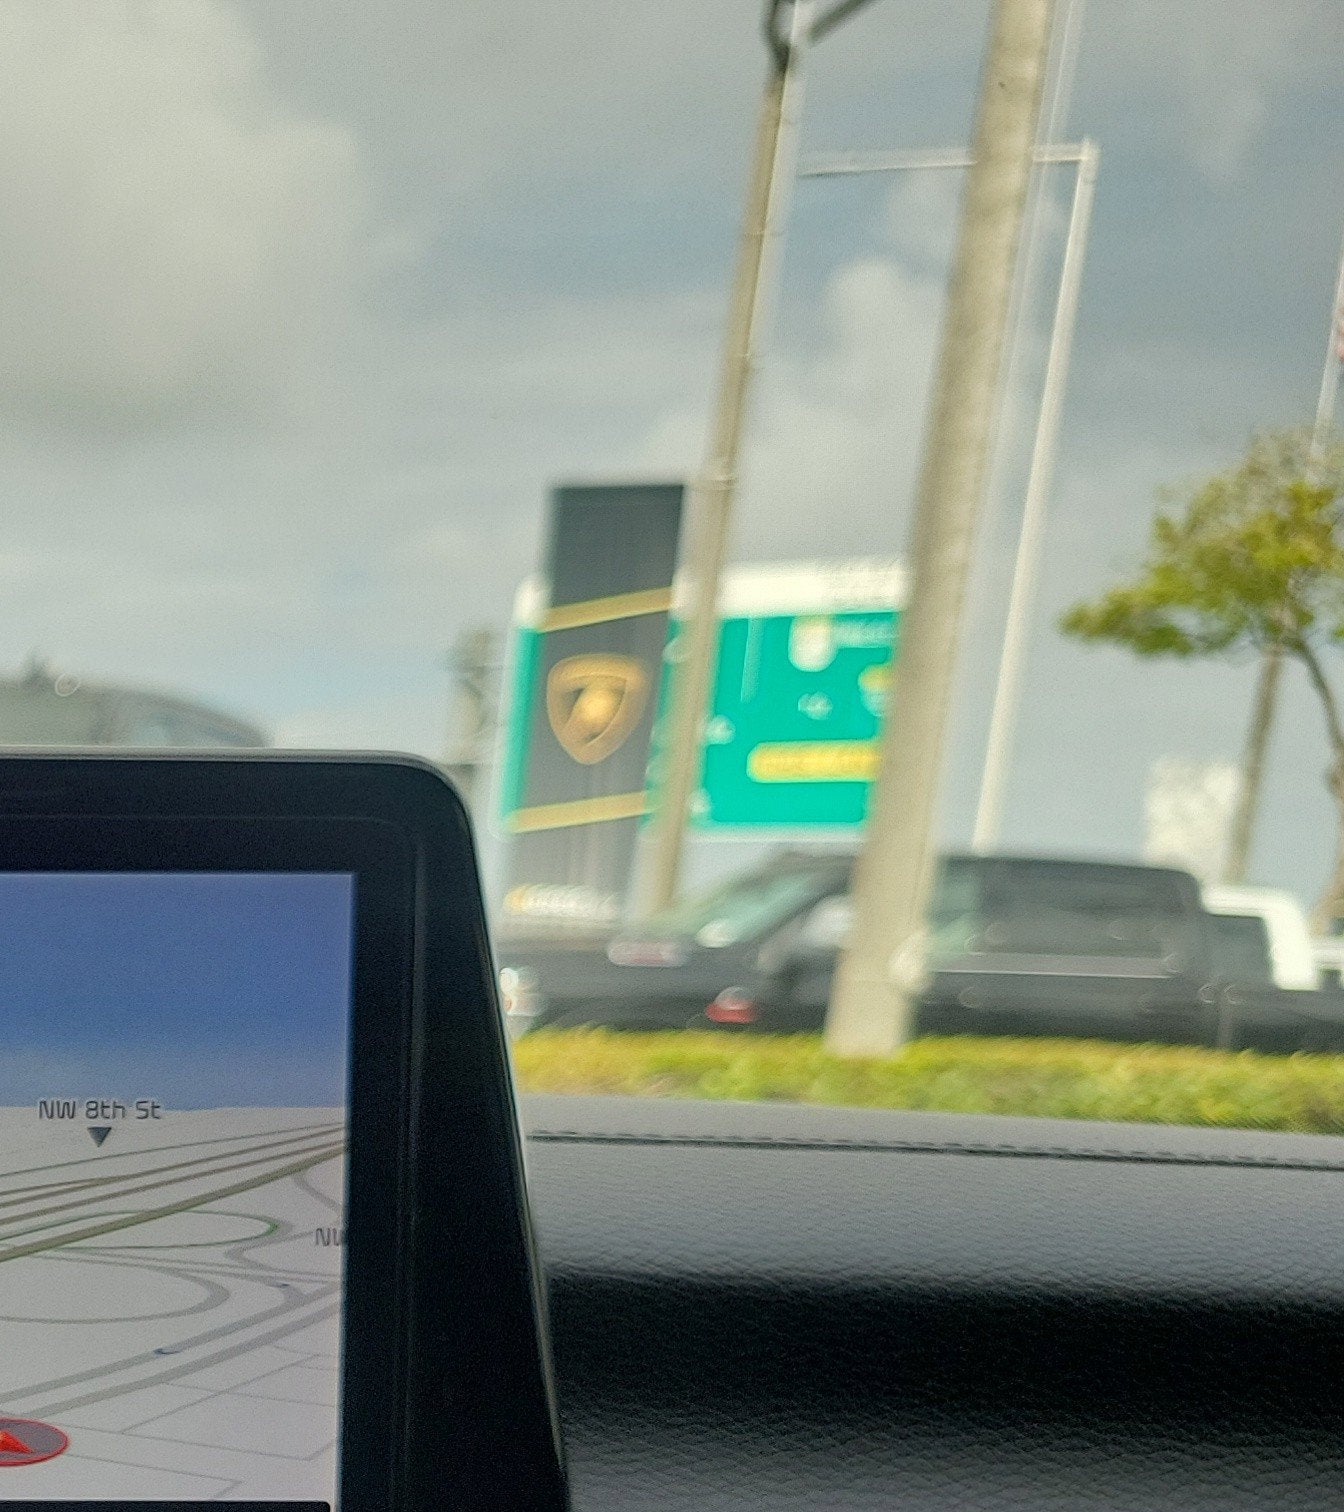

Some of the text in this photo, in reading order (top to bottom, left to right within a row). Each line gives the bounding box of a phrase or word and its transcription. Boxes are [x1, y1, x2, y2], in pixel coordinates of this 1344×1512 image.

[39, 1100, 161, 1119] NW 8th St
